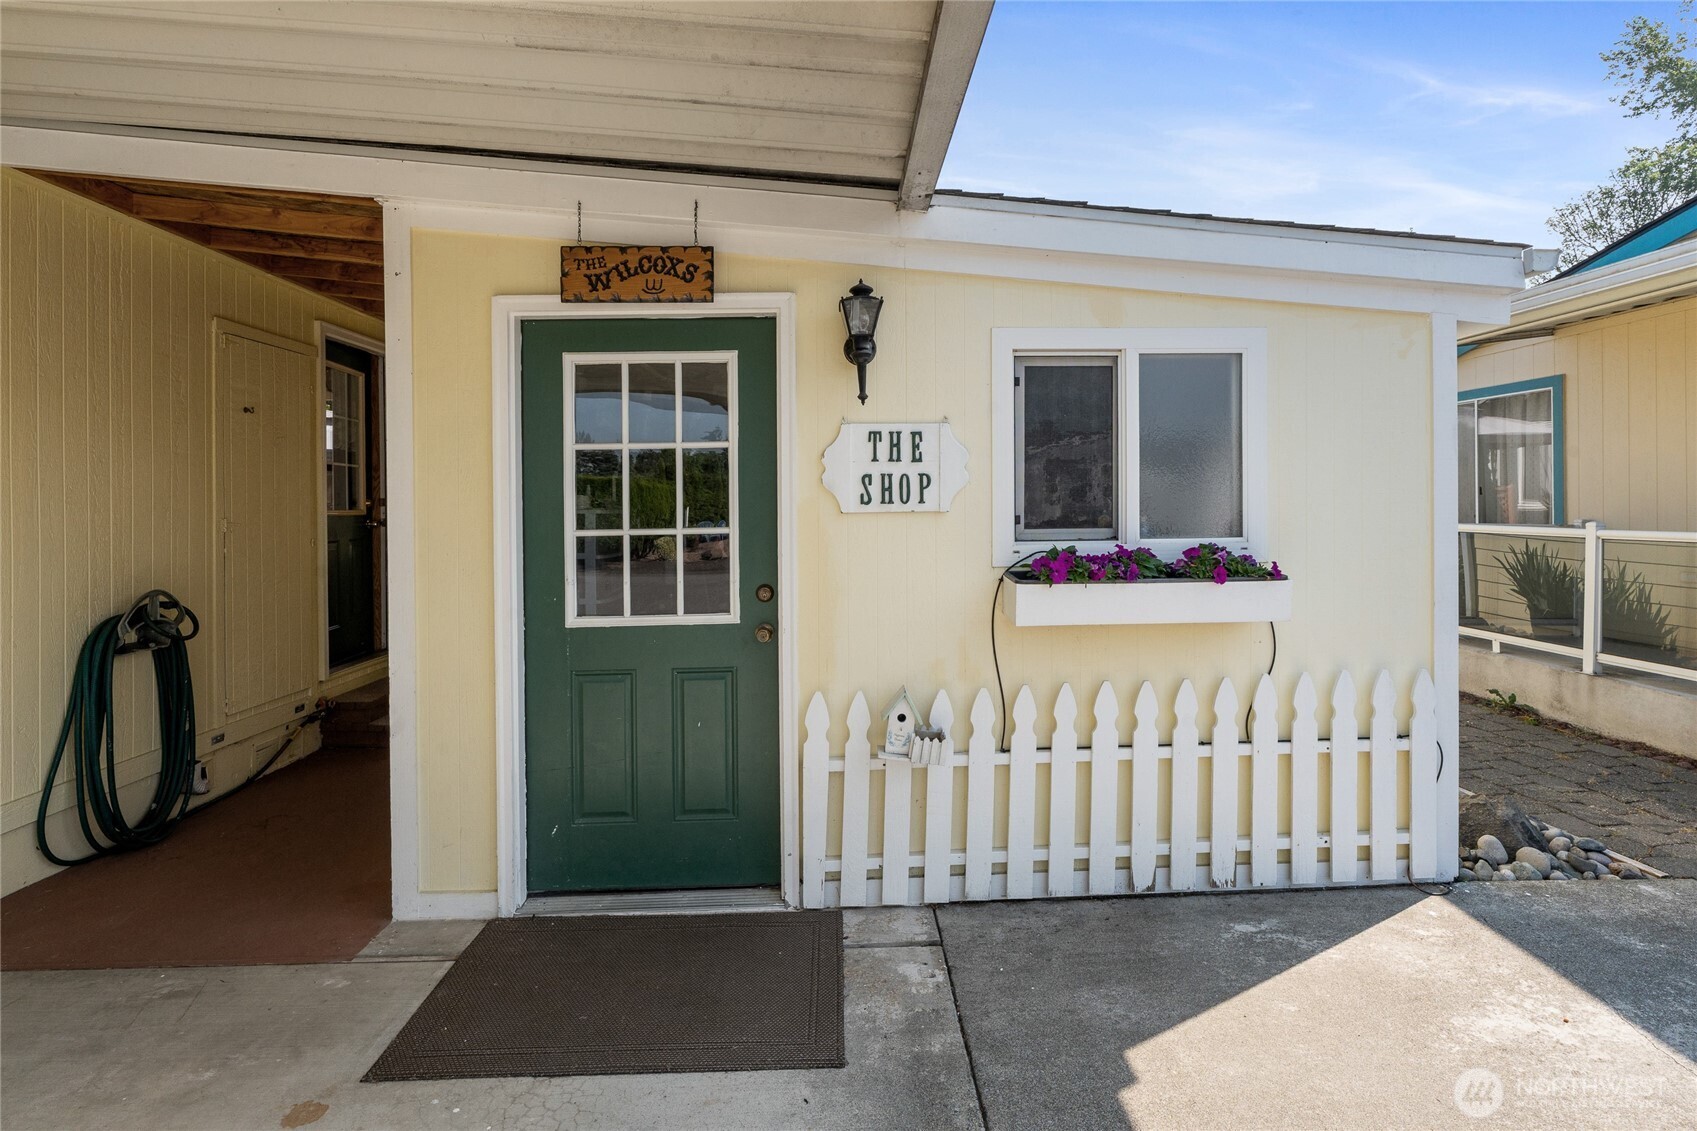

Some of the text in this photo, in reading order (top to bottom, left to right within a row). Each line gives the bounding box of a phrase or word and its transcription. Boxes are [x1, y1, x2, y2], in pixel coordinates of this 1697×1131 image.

[573, 256, 607, 271] THE
[583, 255, 700, 293] WILCOXS
[868, 431, 923, 463] THE
[860, 473, 932, 506] SHOP
